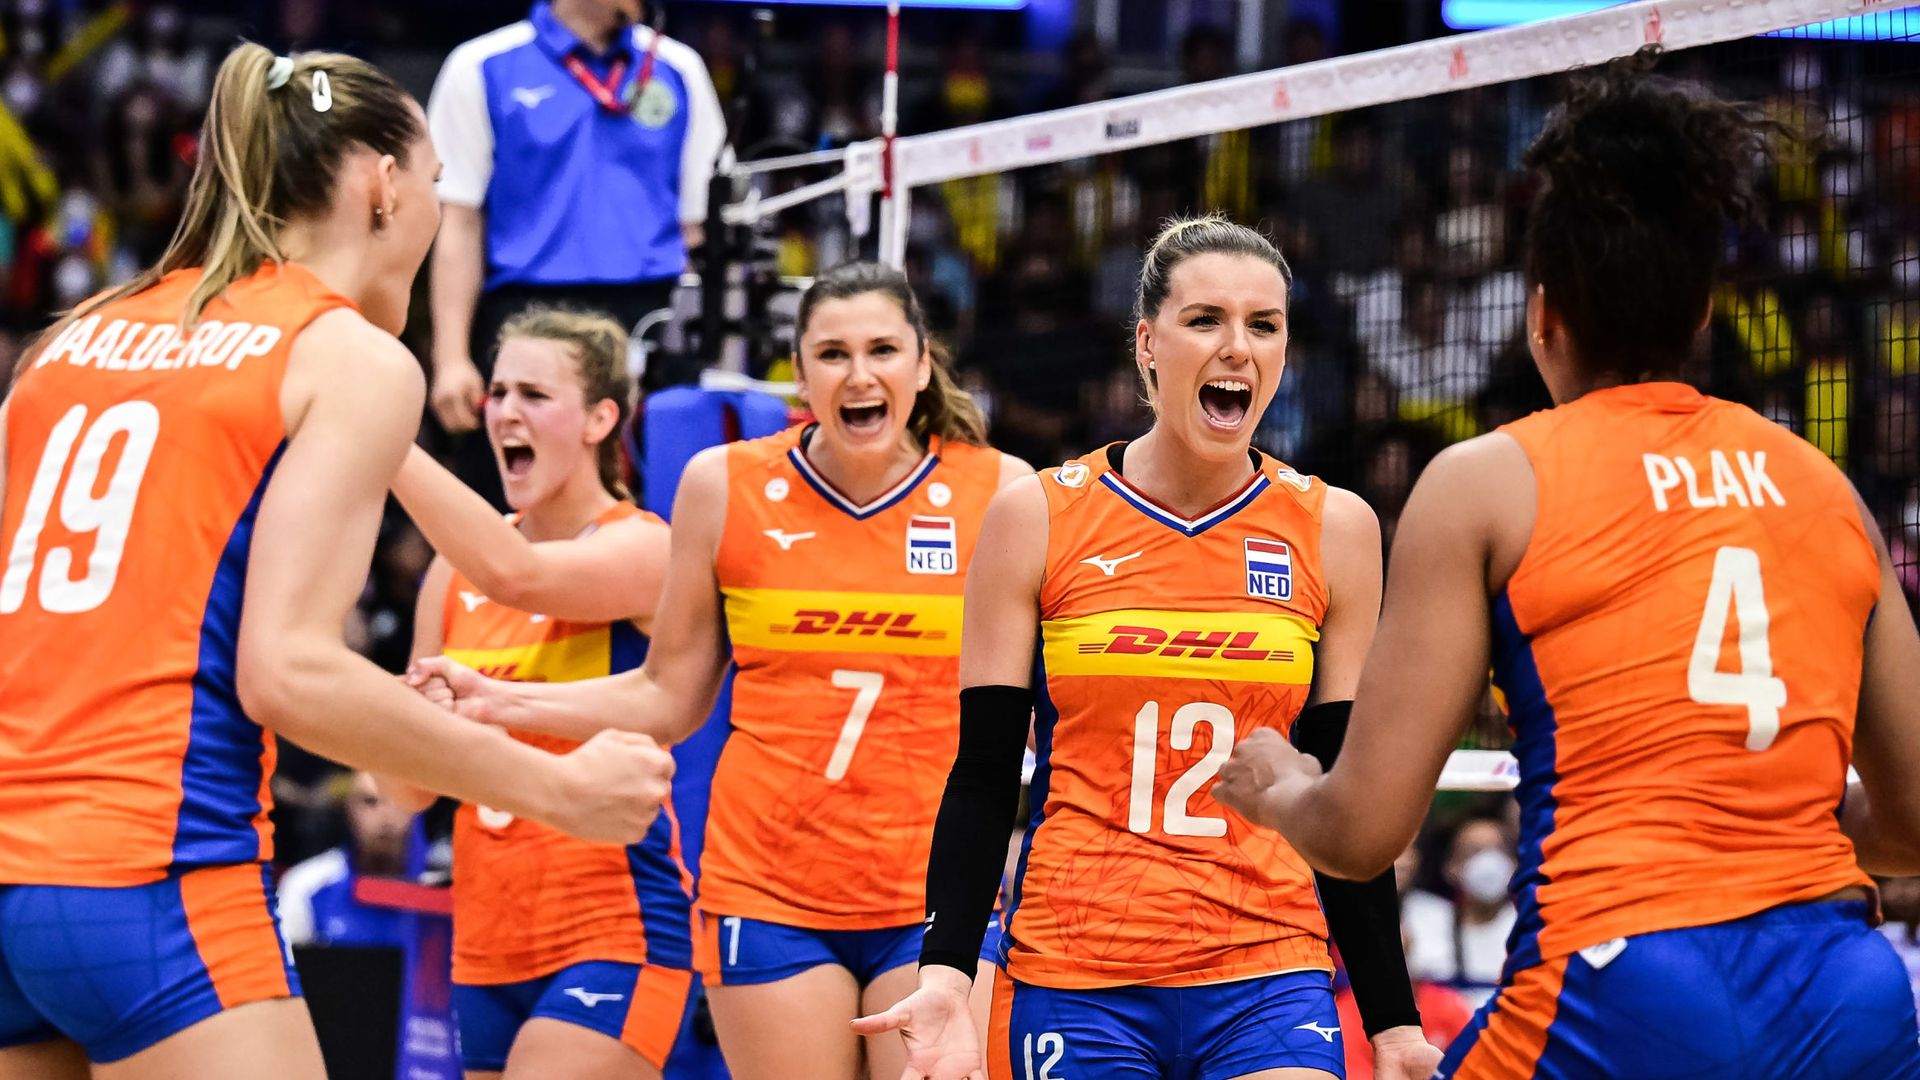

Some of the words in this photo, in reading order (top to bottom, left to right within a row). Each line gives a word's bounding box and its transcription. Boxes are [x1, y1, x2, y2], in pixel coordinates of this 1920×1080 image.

[1643, 449, 1787, 512] PLAK
[0, 400, 160, 614] 19
[911, 551, 953, 570] NED
[1248, 573, 1290, 598] NED
[792, 609, 923, 638] DHL
[1104, 625, 1271, 661] DHL
[1688, 546, 1787, 751] 4
[824, 669, 884, 782] 7
[1128, 700, 1235, 838] 12
[723, 916, 742, 966] 7
[1023, 1032, 1065, 1080] 12
